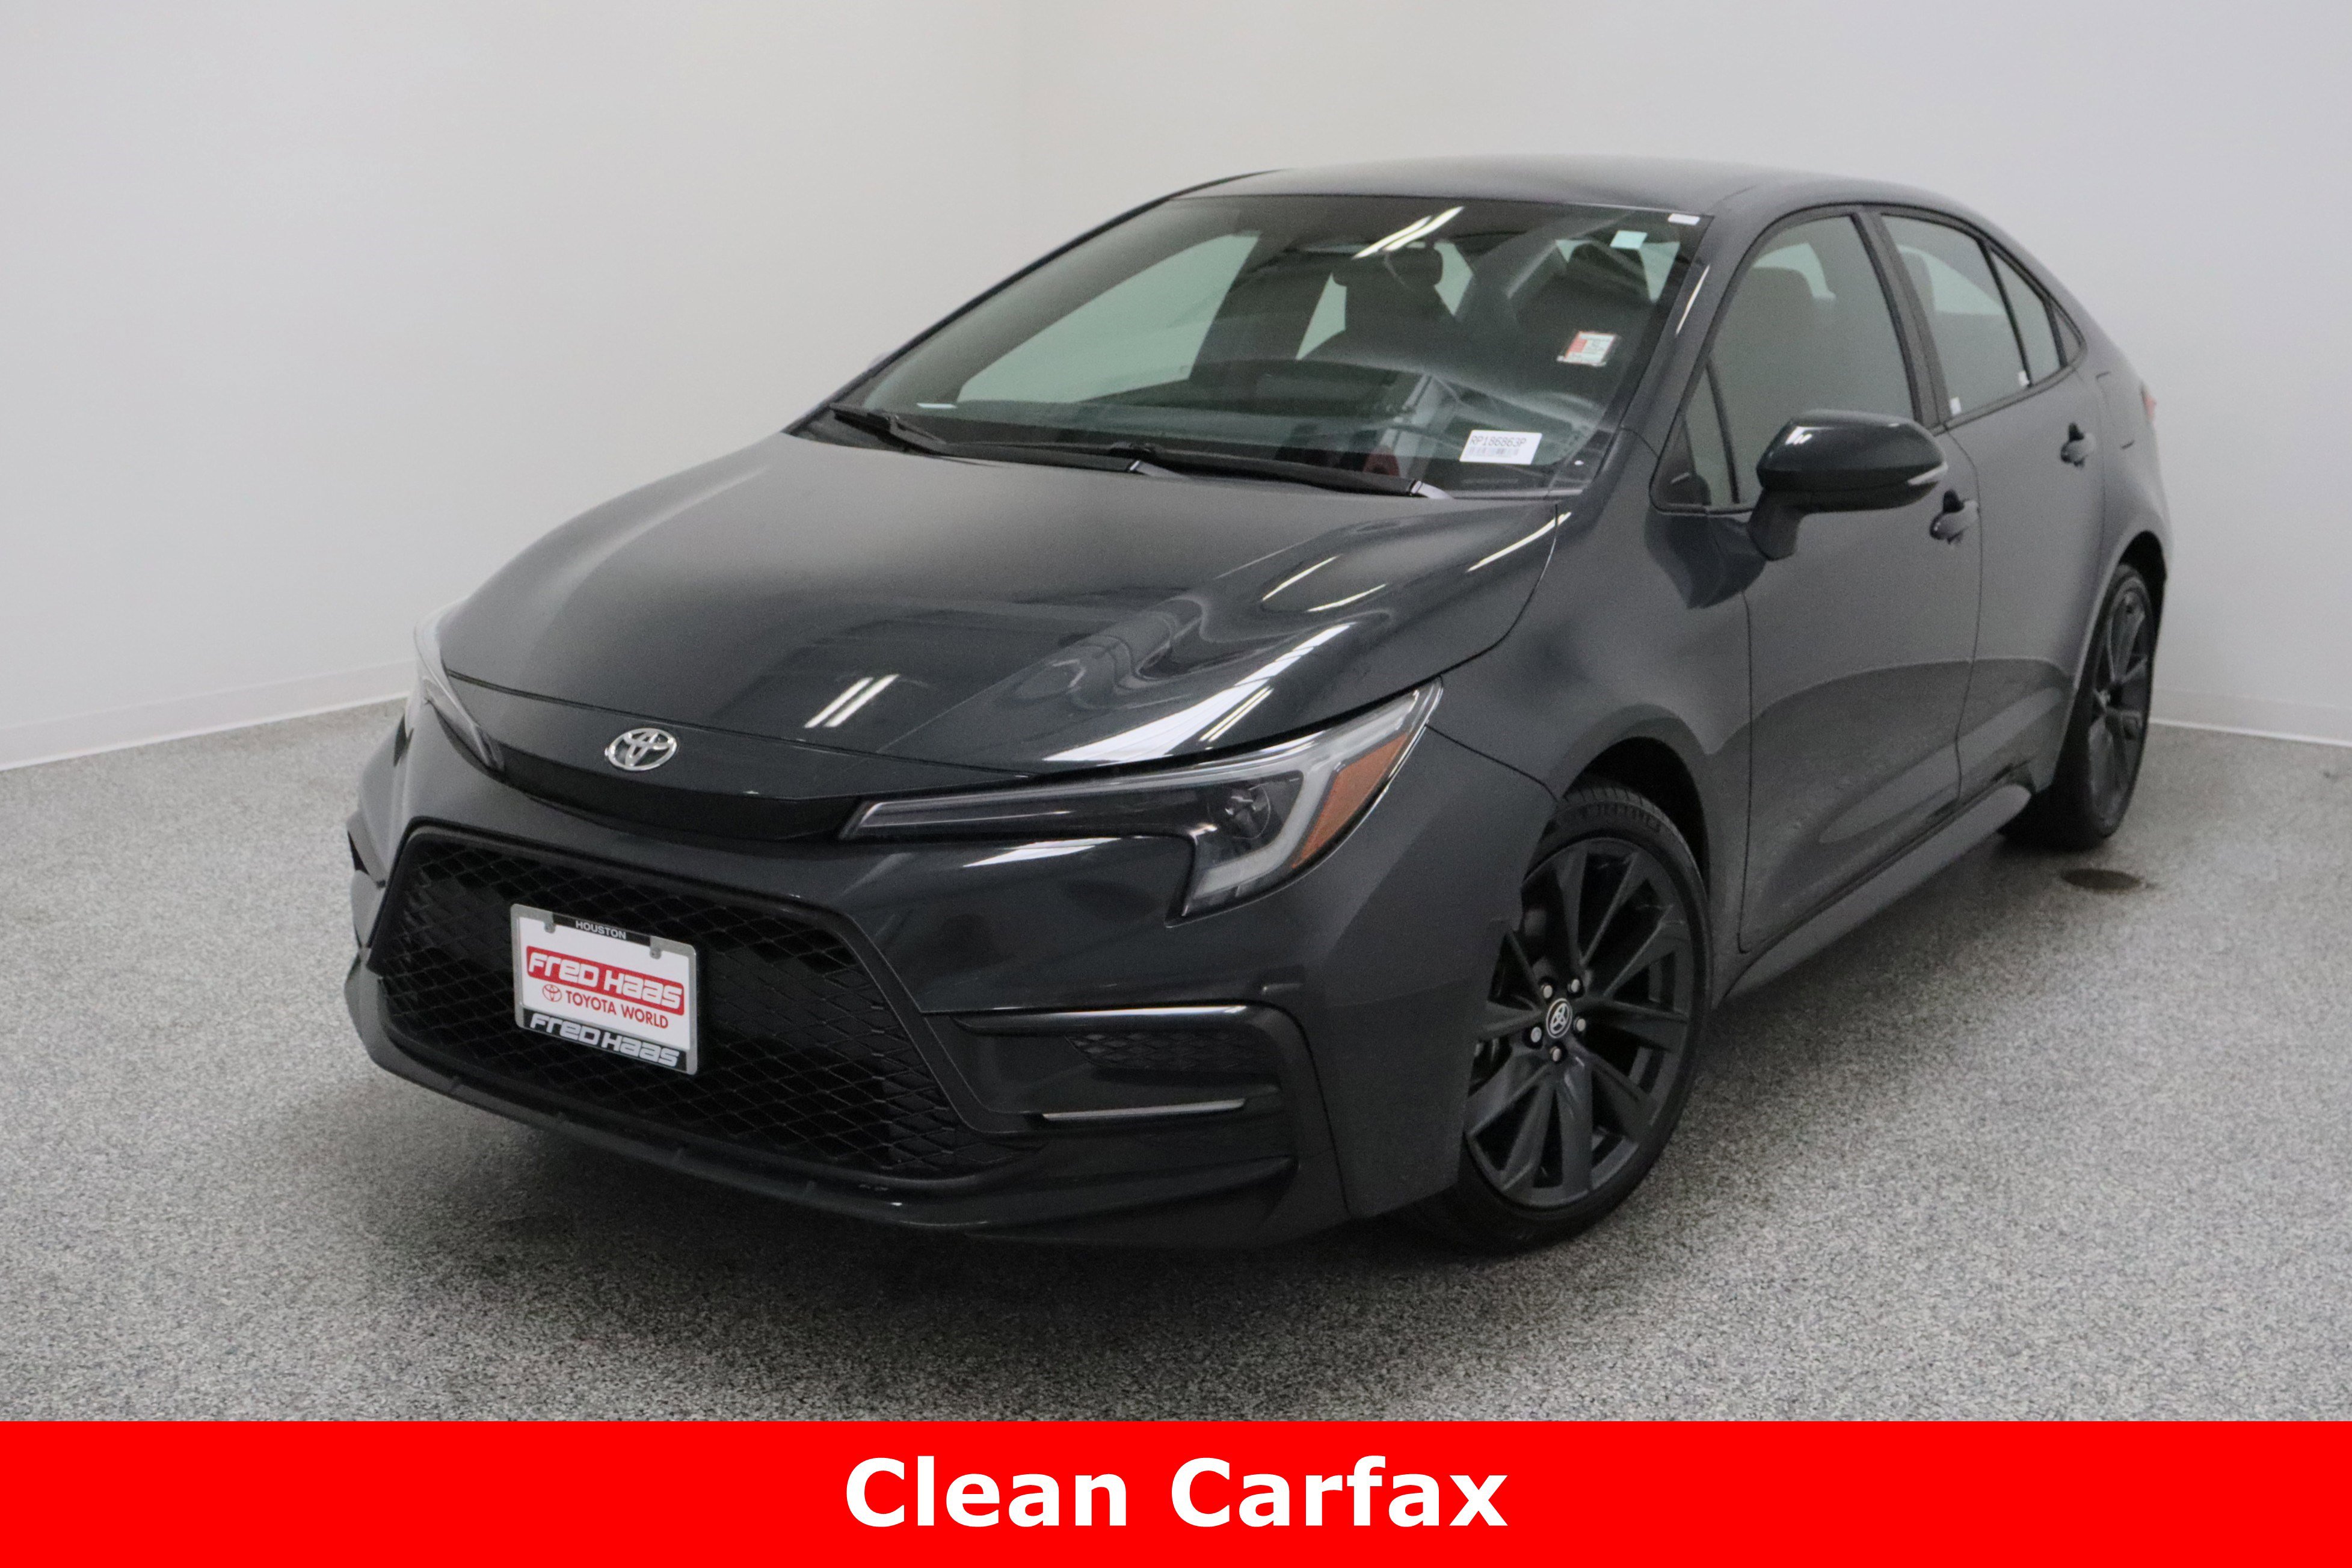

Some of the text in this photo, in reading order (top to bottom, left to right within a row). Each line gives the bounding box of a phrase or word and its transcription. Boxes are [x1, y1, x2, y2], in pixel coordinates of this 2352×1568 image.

[575, 920, 627, 940] HOUSTON
[565, 990, 669, 1030] TOYOTA WORLD
